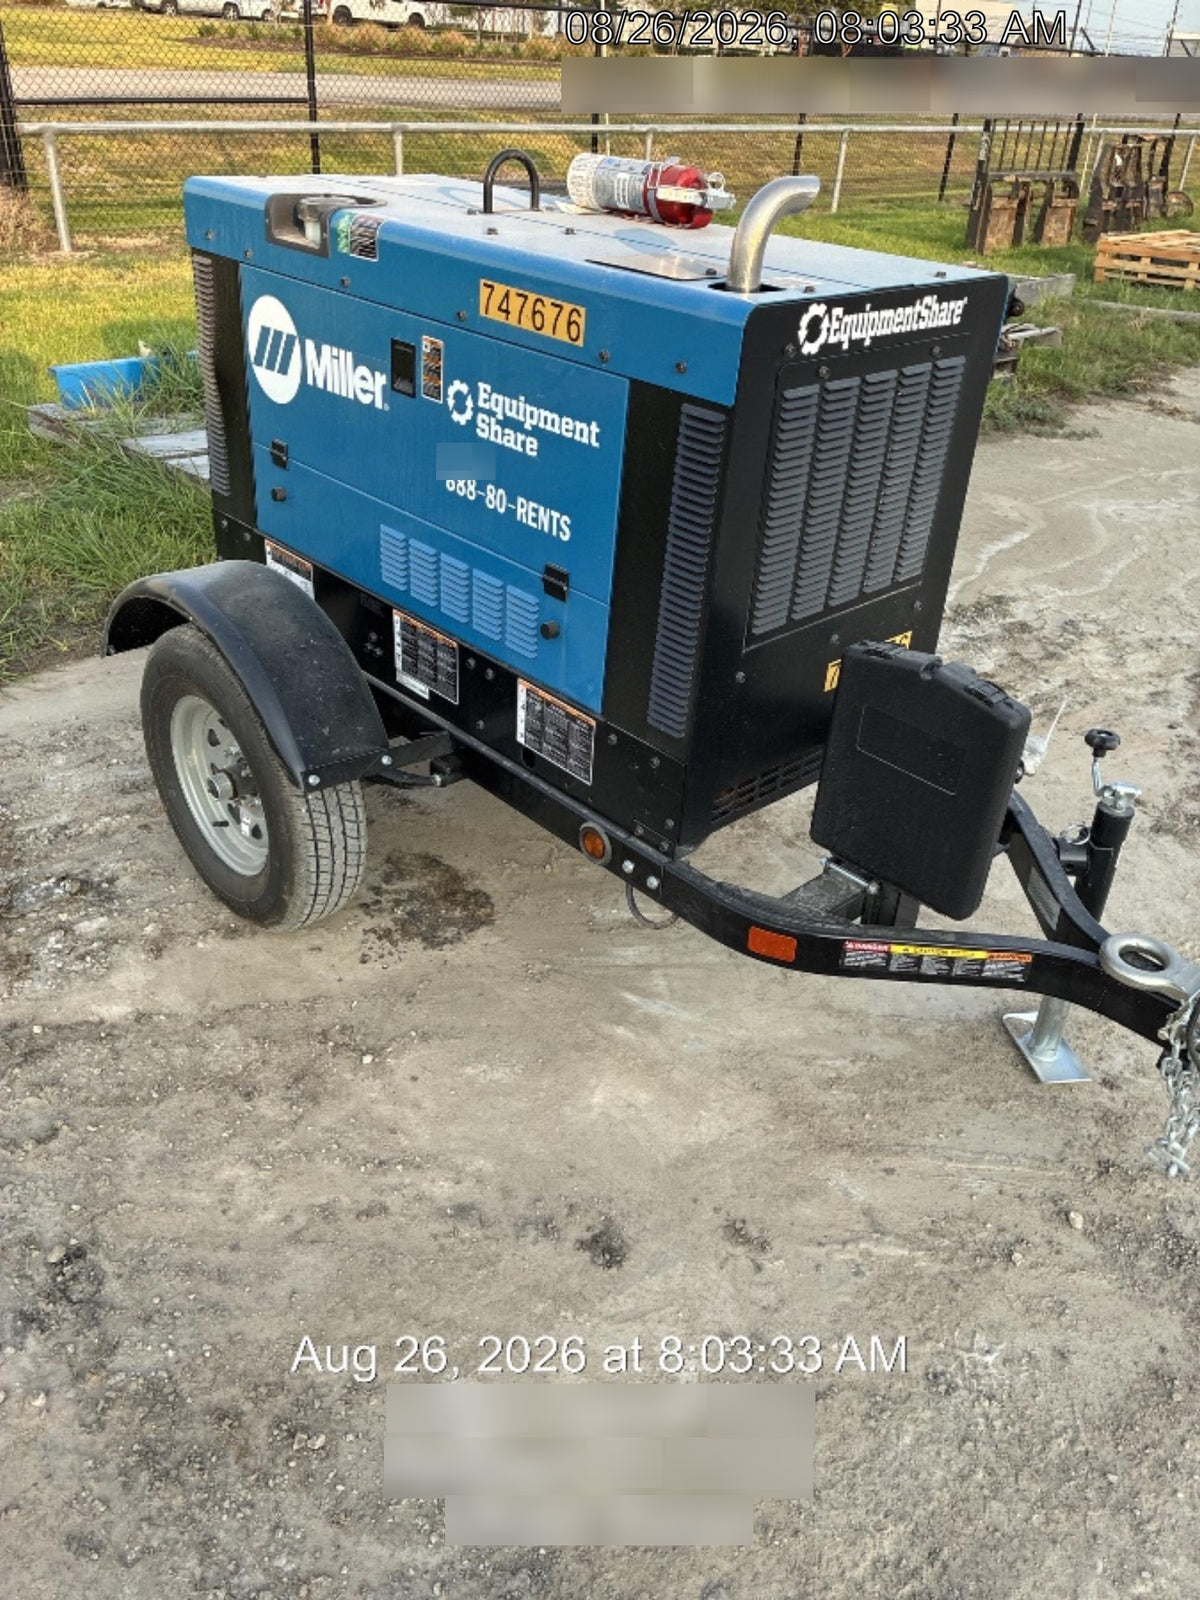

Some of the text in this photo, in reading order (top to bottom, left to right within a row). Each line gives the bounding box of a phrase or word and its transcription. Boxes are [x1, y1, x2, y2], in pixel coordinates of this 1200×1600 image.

[483, 282, 582, 342] 747676
[828, 294, 963, 350] EquipmentShare
[305, 338, 387, 410] Miller
[476, 412, 538, 456] Share
[477, 381, 600, 447] Equipment
